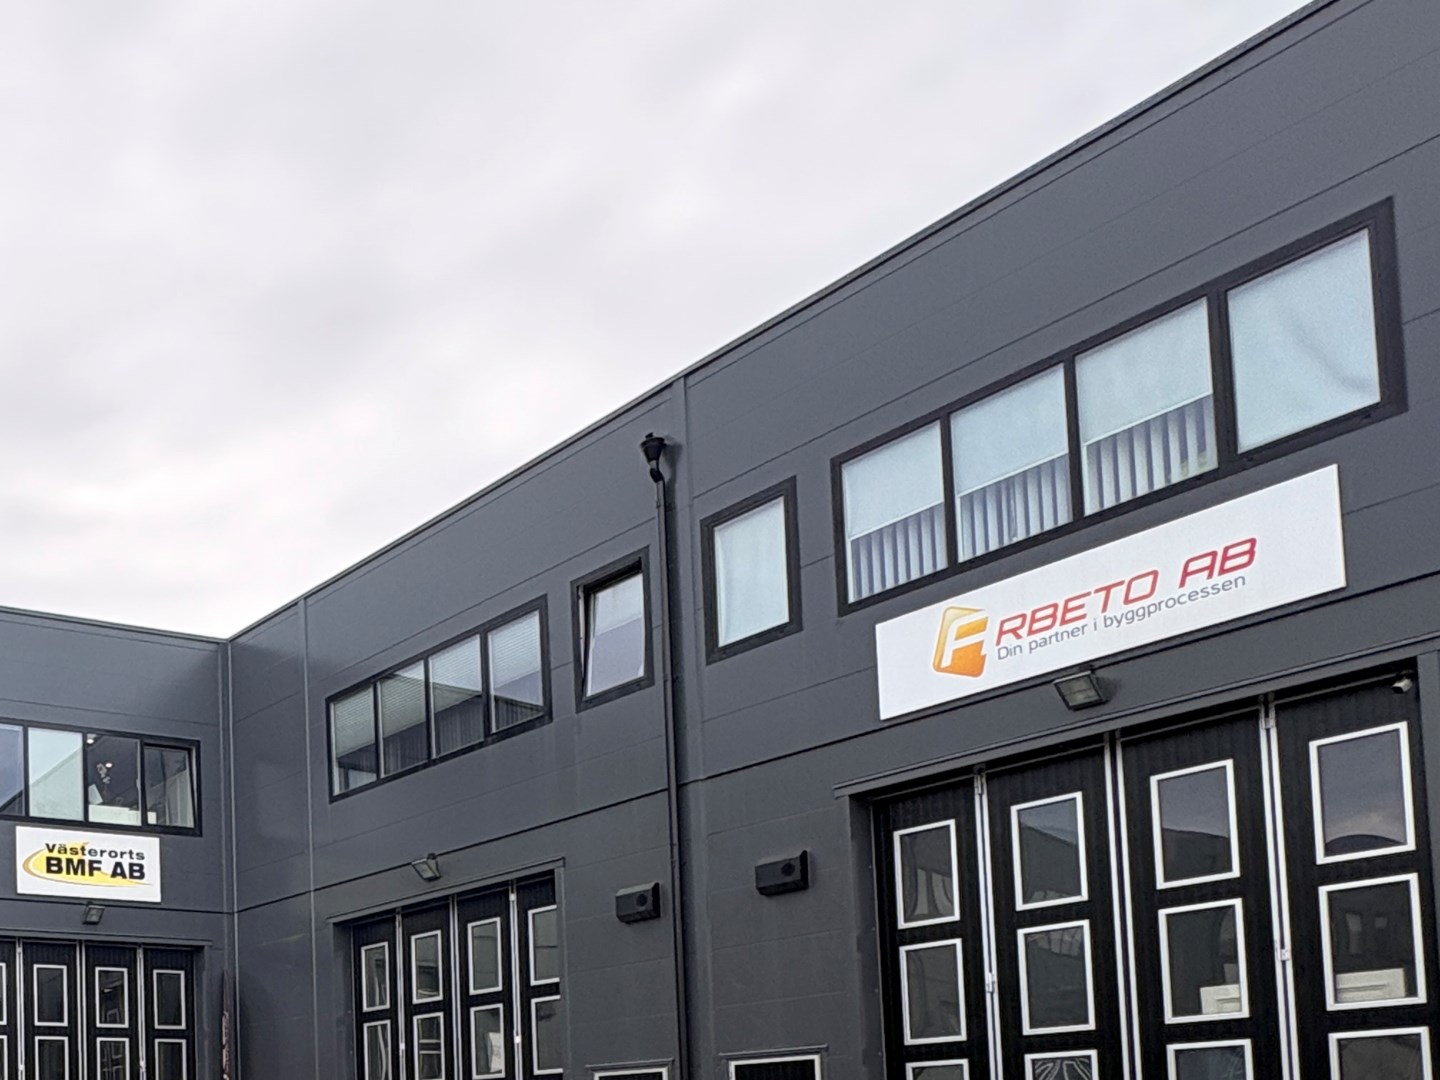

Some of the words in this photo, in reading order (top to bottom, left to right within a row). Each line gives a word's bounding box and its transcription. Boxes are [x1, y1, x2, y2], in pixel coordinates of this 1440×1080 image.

[1177, 537, 1258, 589] AB
[996, 643, 1023, 661] Din
[1028, 622, 1089, 655] partner
[1103, 574, 1247, 629] byggprocessen
[45, 842, 146, 861] Västerorts
[45, 856, 103, 877] BMF
[110, 861, 146, 881] AB
